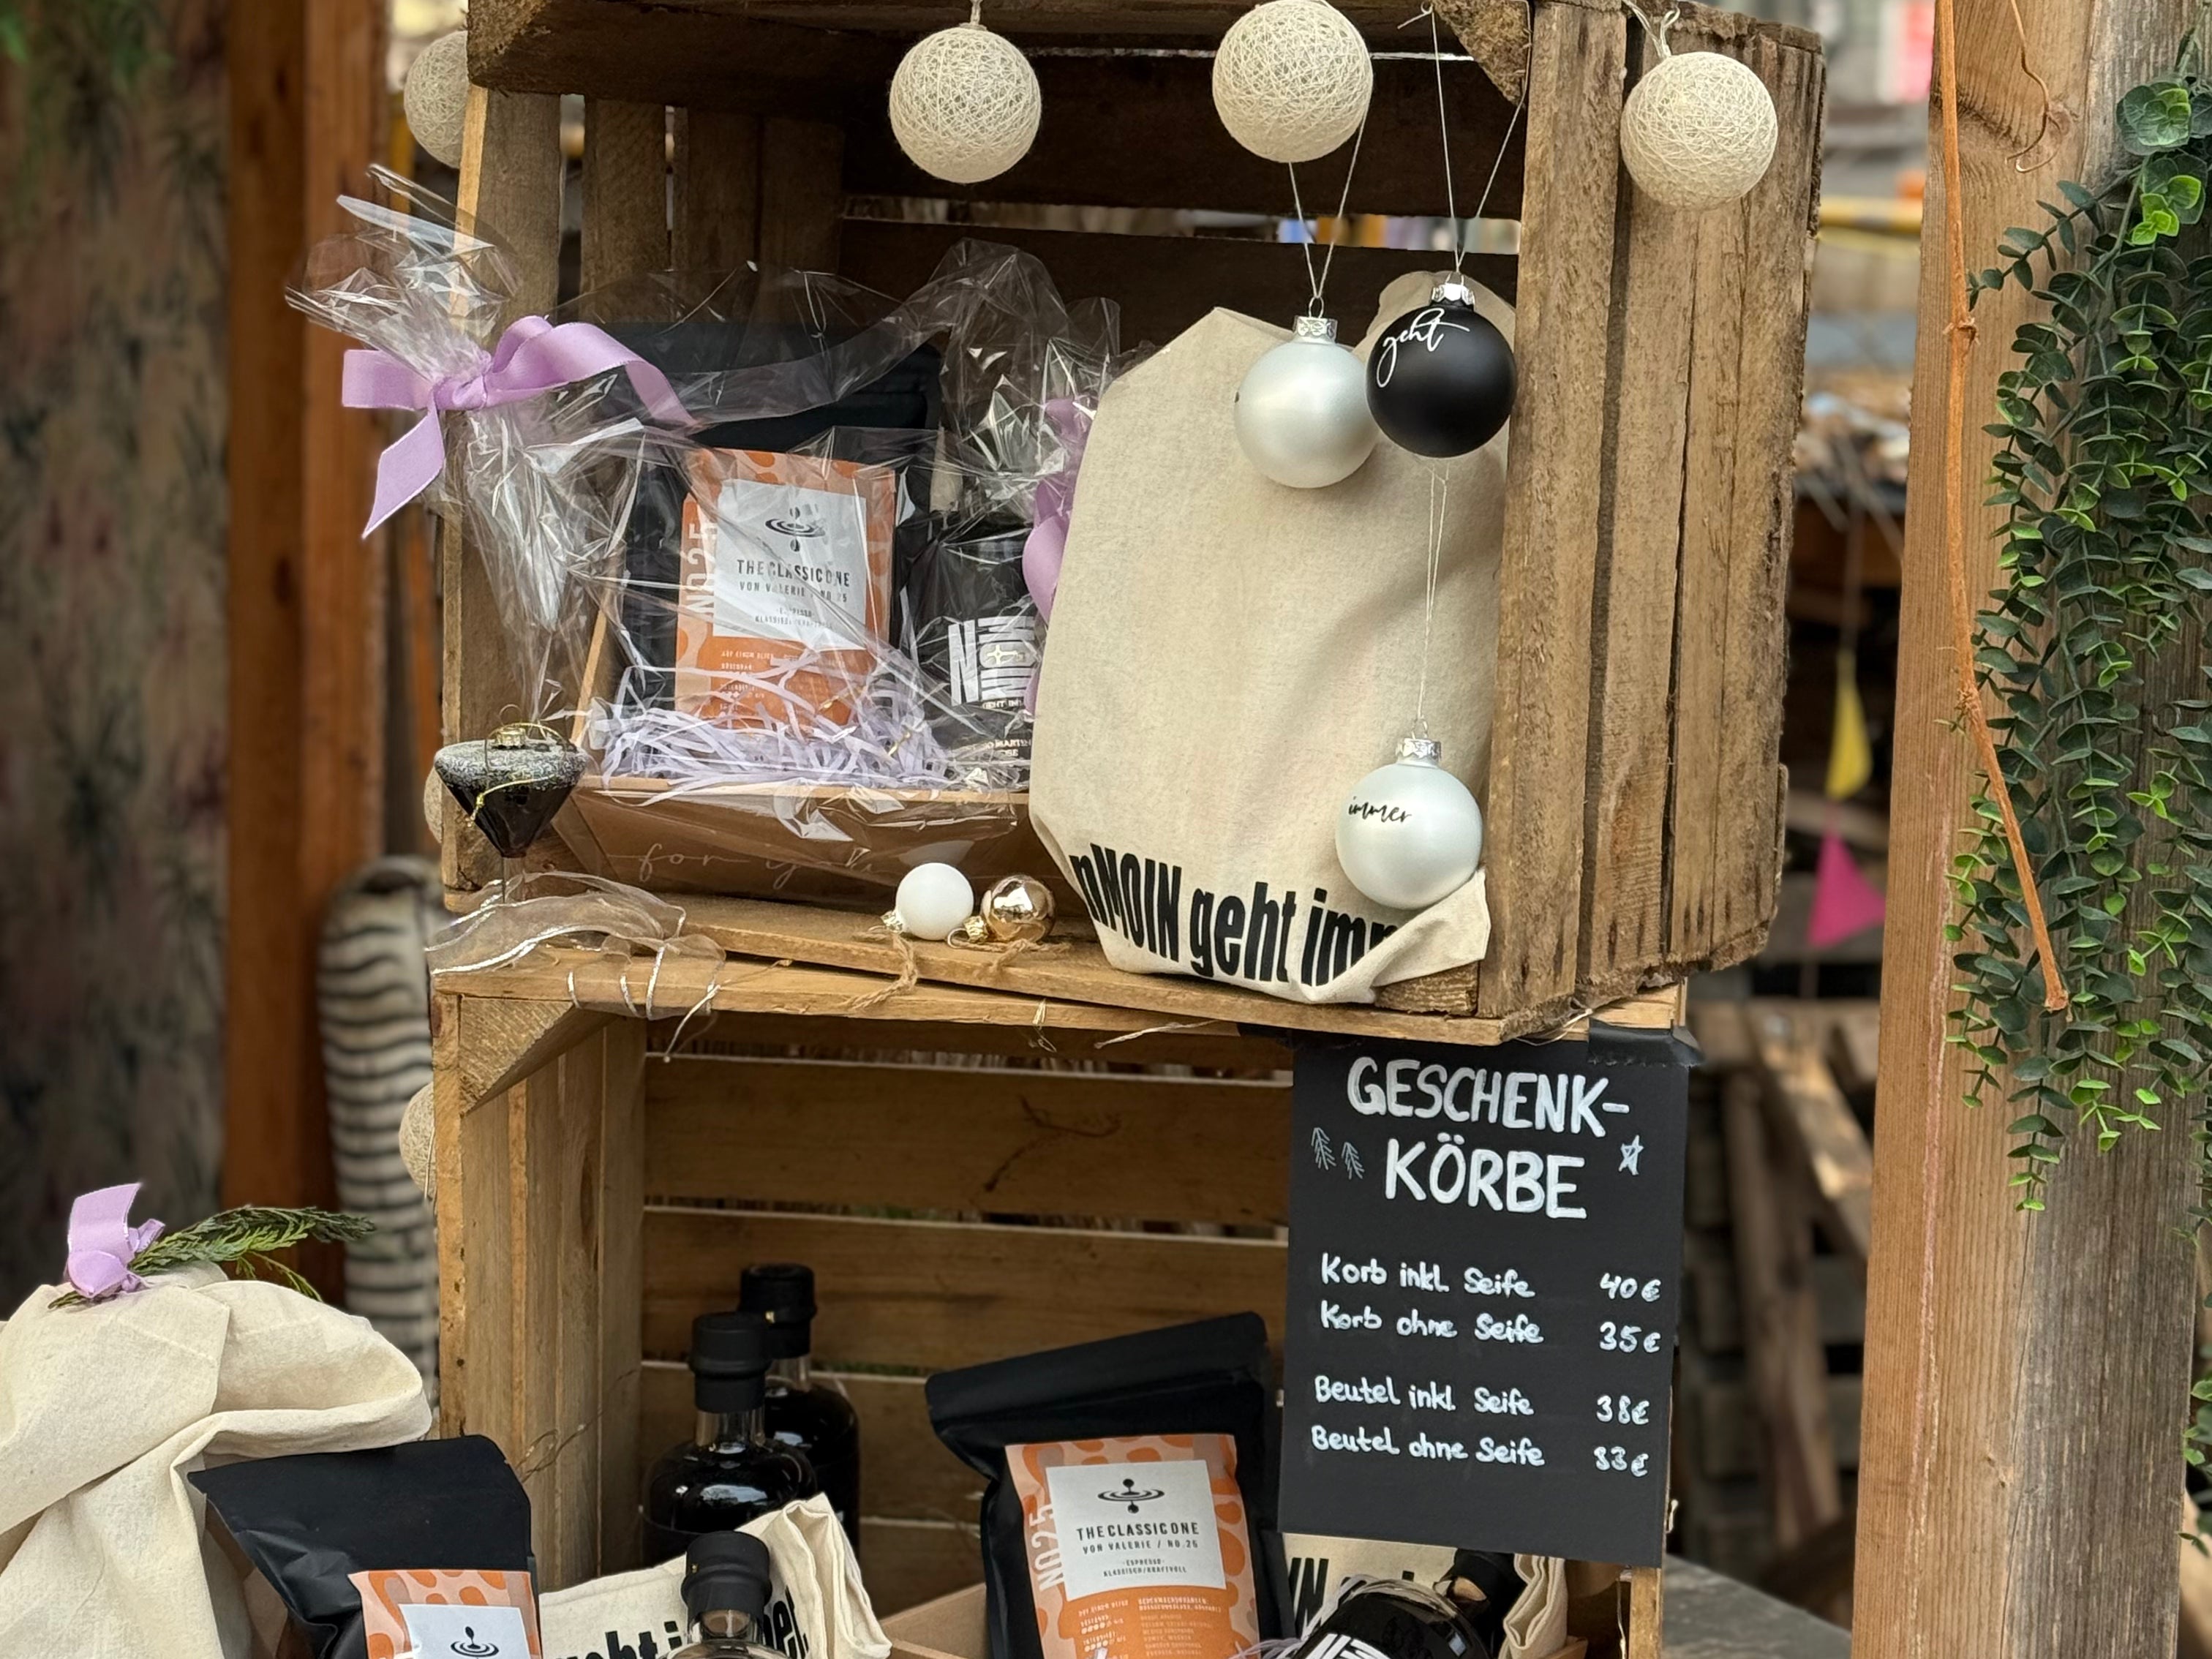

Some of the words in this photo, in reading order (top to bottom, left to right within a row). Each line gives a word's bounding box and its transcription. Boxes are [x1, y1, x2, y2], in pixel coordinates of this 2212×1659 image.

[1348, 795, 1412, 823] immer
[607, 842, 751, 883] for
[1189, 881, 1297, 983] geht
[1347, 1056, 1630, 1138] GESCHENK-
[1384, 1132, 1587, 1219] KÖRBE
[1320, 1252, 1388, 1285] Korb
[1463, 1266, 1536, 1298] Seife
[1320, 1298, 1383, 1331] Korb
[1395, 1307, 1459, 1339] ohne
[1473, 1312, 1545, 1344] Seife
[1314, 1374, 1402, 1406] Beutel
[1473, 1385, 1535, 1416] Seife
[1310, 1423, 1401, 1456] Beutel
[1408, 1431, 1469, 1462] ohne
[1475, 1436, 1546, 1467] Seife
[1083, 1543, 1103, 1555] VON
[1108, 1539, 1152, 1551] VALERIE
